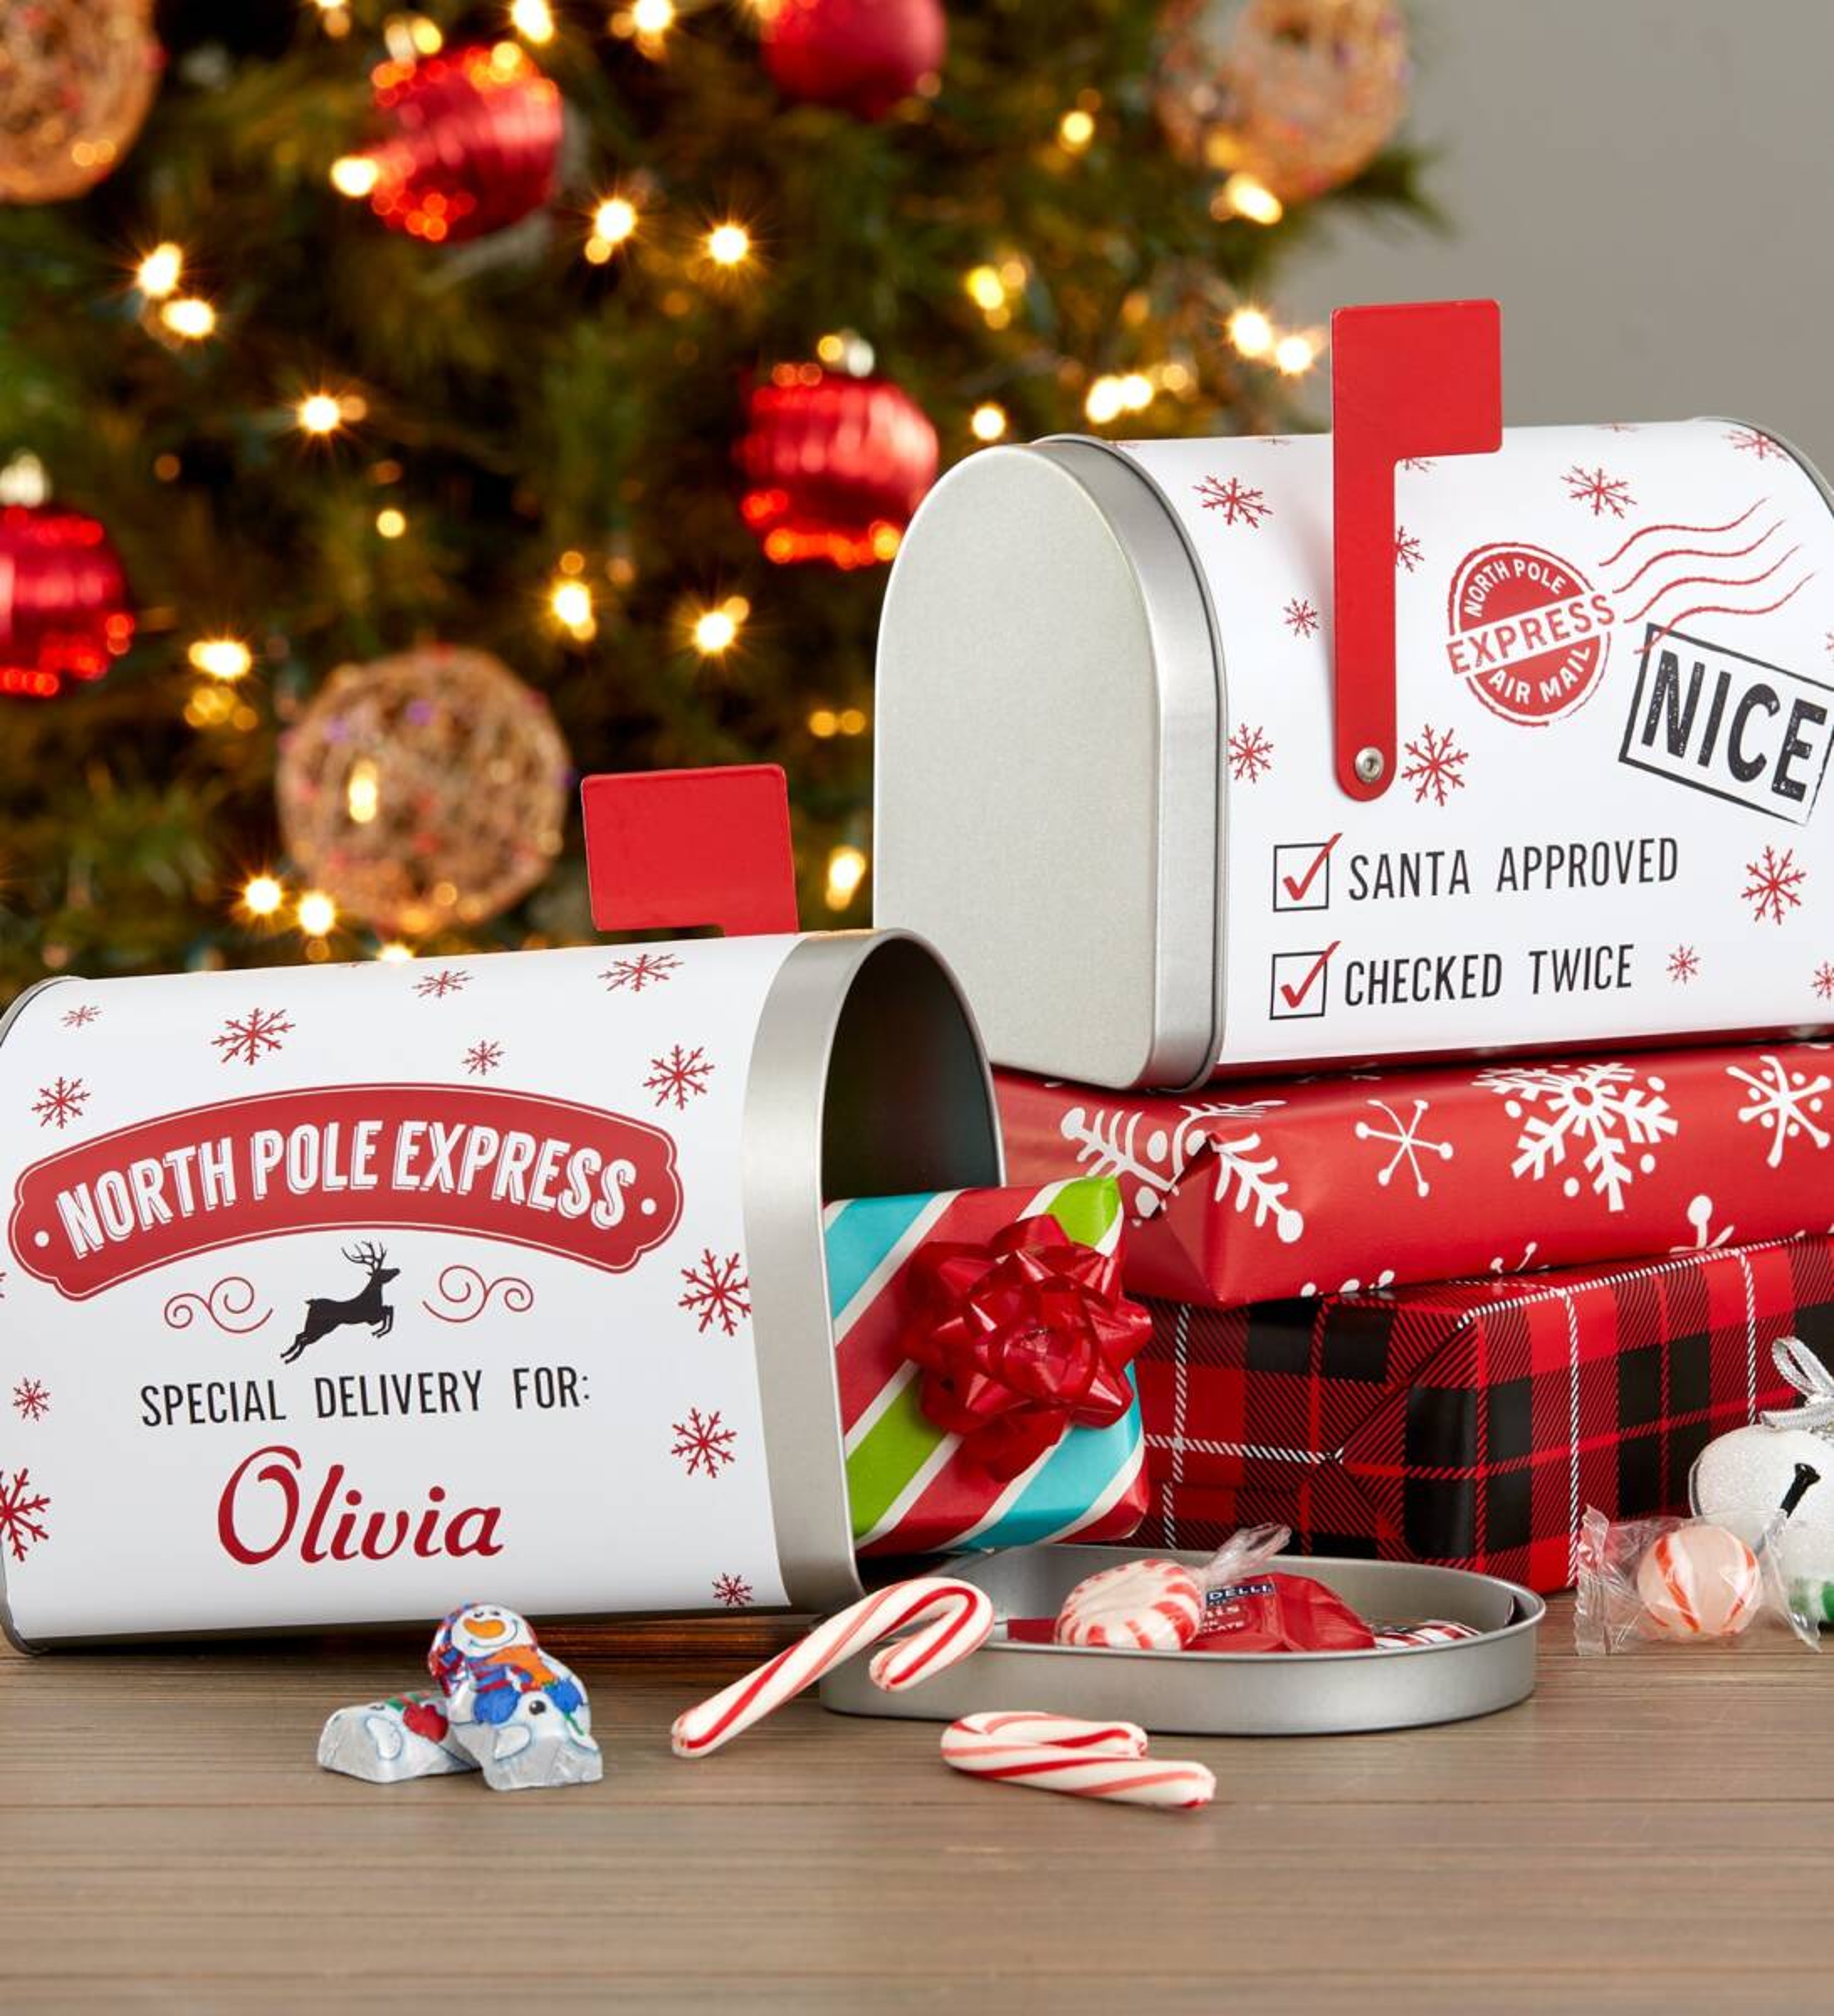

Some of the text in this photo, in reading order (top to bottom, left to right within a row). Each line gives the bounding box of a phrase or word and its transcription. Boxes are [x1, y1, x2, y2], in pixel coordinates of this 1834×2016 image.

[1463, 558, 1566, 618] NORTH POLE
[1446, 594, 1614, 675] EXPRESS
[1488, 645, 1591, 704] AIR MAIL
[1641, 650, 1828, 803] NICE
[1348, 837, 1678, 901] SANTA APPROVED
[1344, 944, 1634, 1007] CHECKED TWICE
[56, 1121, 637, 1260] NORTH POLE EXPRESS
[140, 1366, 590, 1427] SPECIAL DELIVERY FOR:
[217, 1445, 504, 1566] Olivia
